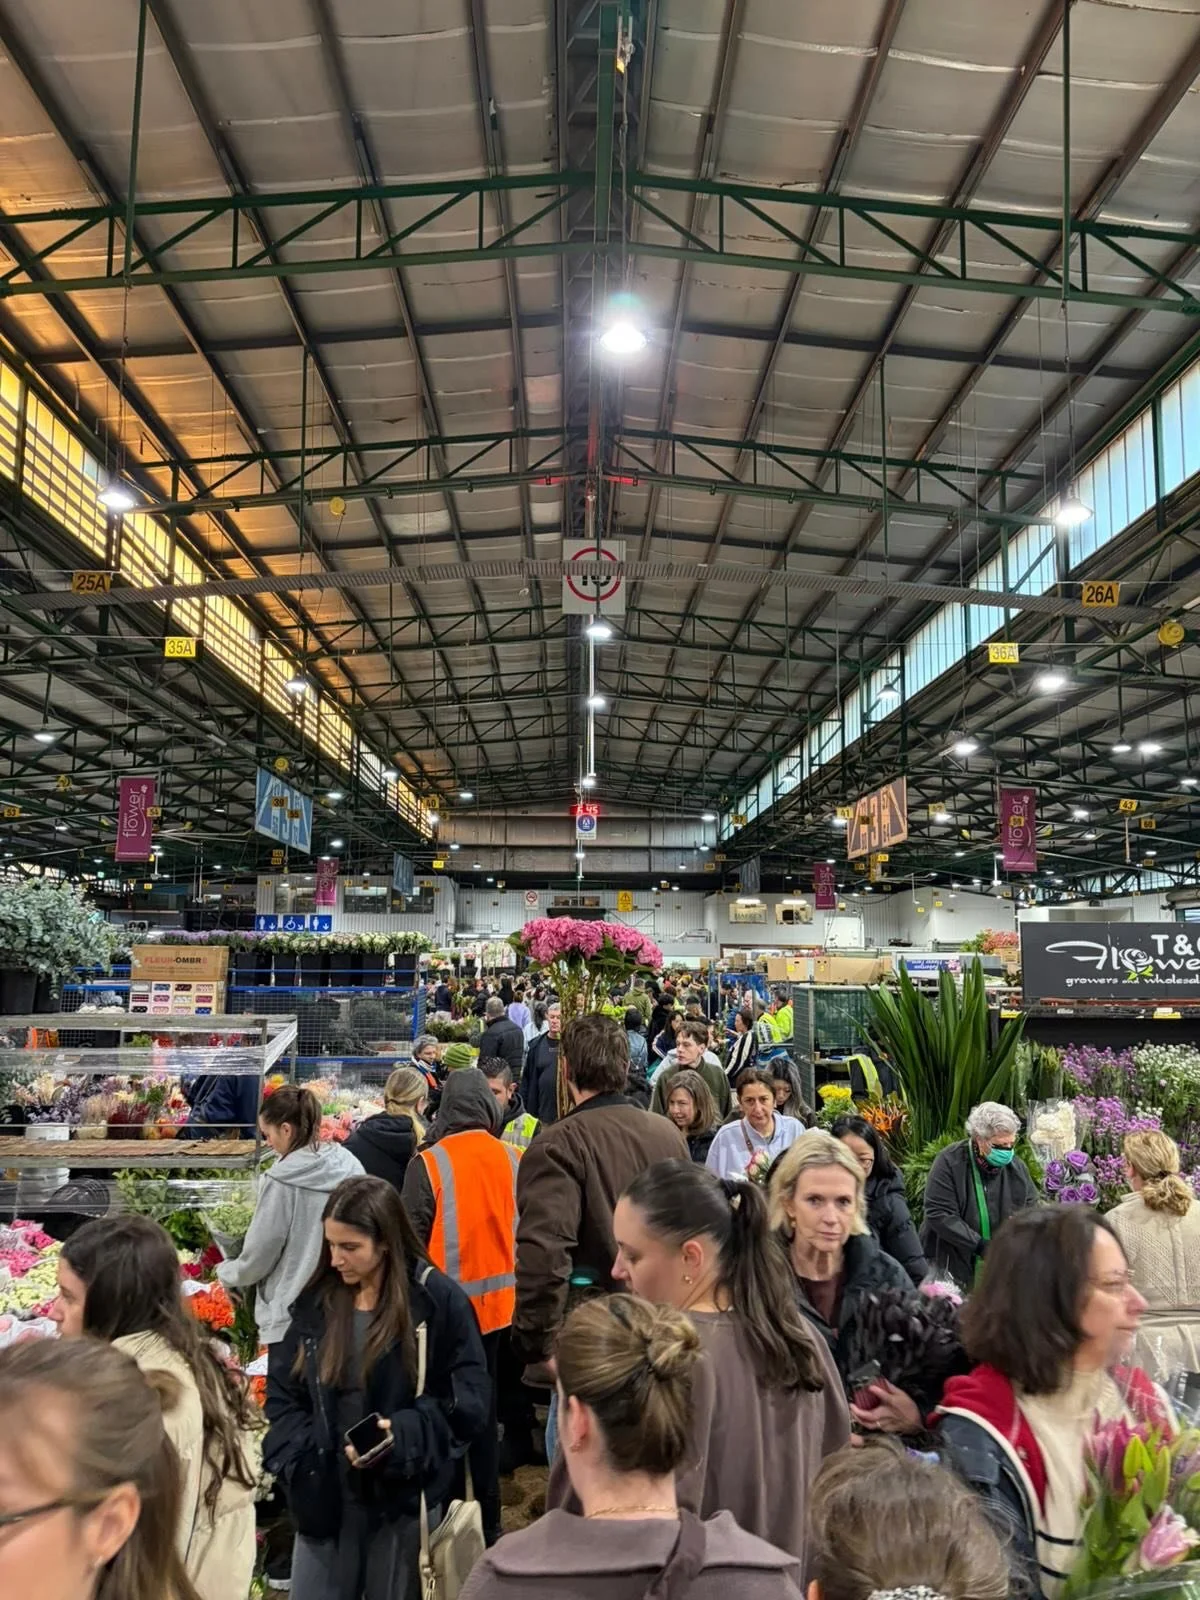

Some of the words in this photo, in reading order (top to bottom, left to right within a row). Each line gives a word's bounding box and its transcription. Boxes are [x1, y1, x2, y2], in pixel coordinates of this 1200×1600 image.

[77, 574, 106, 591] 25A
[1086, 585, 1115, 603] 26A
[168, 640, 193, 655] 35A
[122, 788, 140, 838] flower
[1122, 801, 1134, 810] 43
[1008, 798, 1023, 848] floer
[1151, 934, 1200, 956] T&
[1066, 977, 1118, 987] growers
